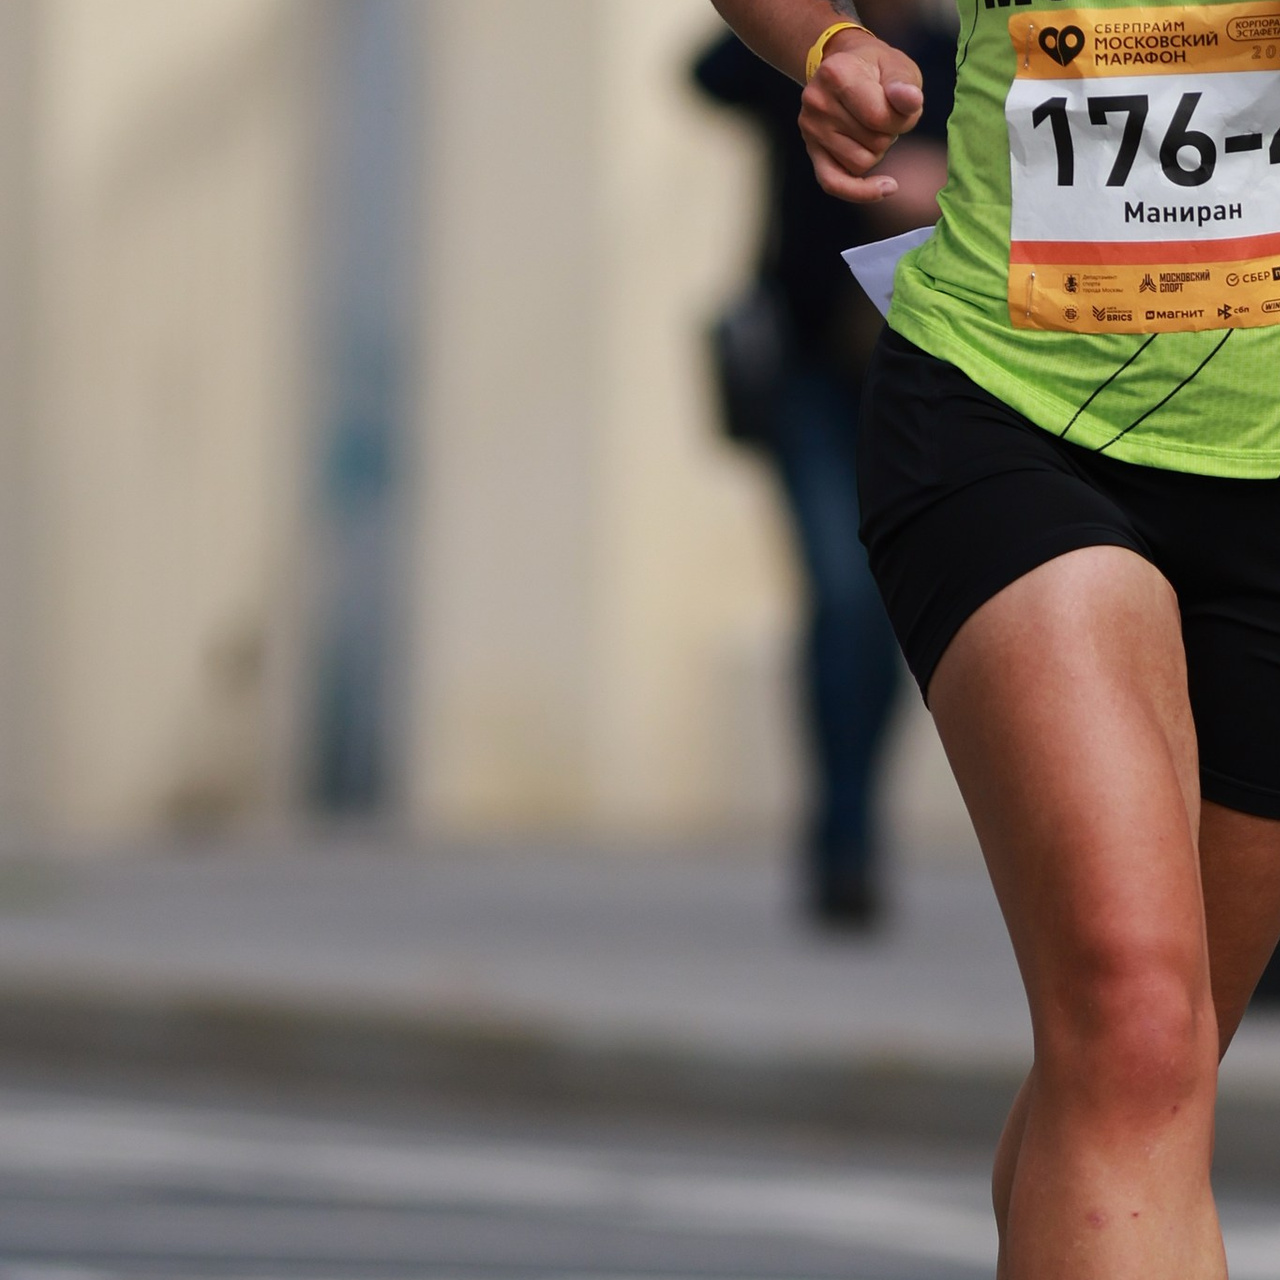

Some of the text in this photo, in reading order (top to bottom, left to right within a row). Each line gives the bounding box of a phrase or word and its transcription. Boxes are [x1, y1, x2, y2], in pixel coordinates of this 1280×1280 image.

[1094, 20, 1185, 34] СБЕРПРАЙМ
[1094, 31, 1219, 51] МОСКОВСКИЙ
[1094, 50, 1186, 66] МАРАФОН
[1124, 201, 1243, 227] Маниран
[1159, 269, 1211, 282] МОСКОВСКИЙ
[1242, 271, 1271, 283] СБЕР
[1159, 283, 1184, 293] СПОРТ
[1233, 305, 1250, 314] сбп
[1106, 313, 1133, 322] BRICS
